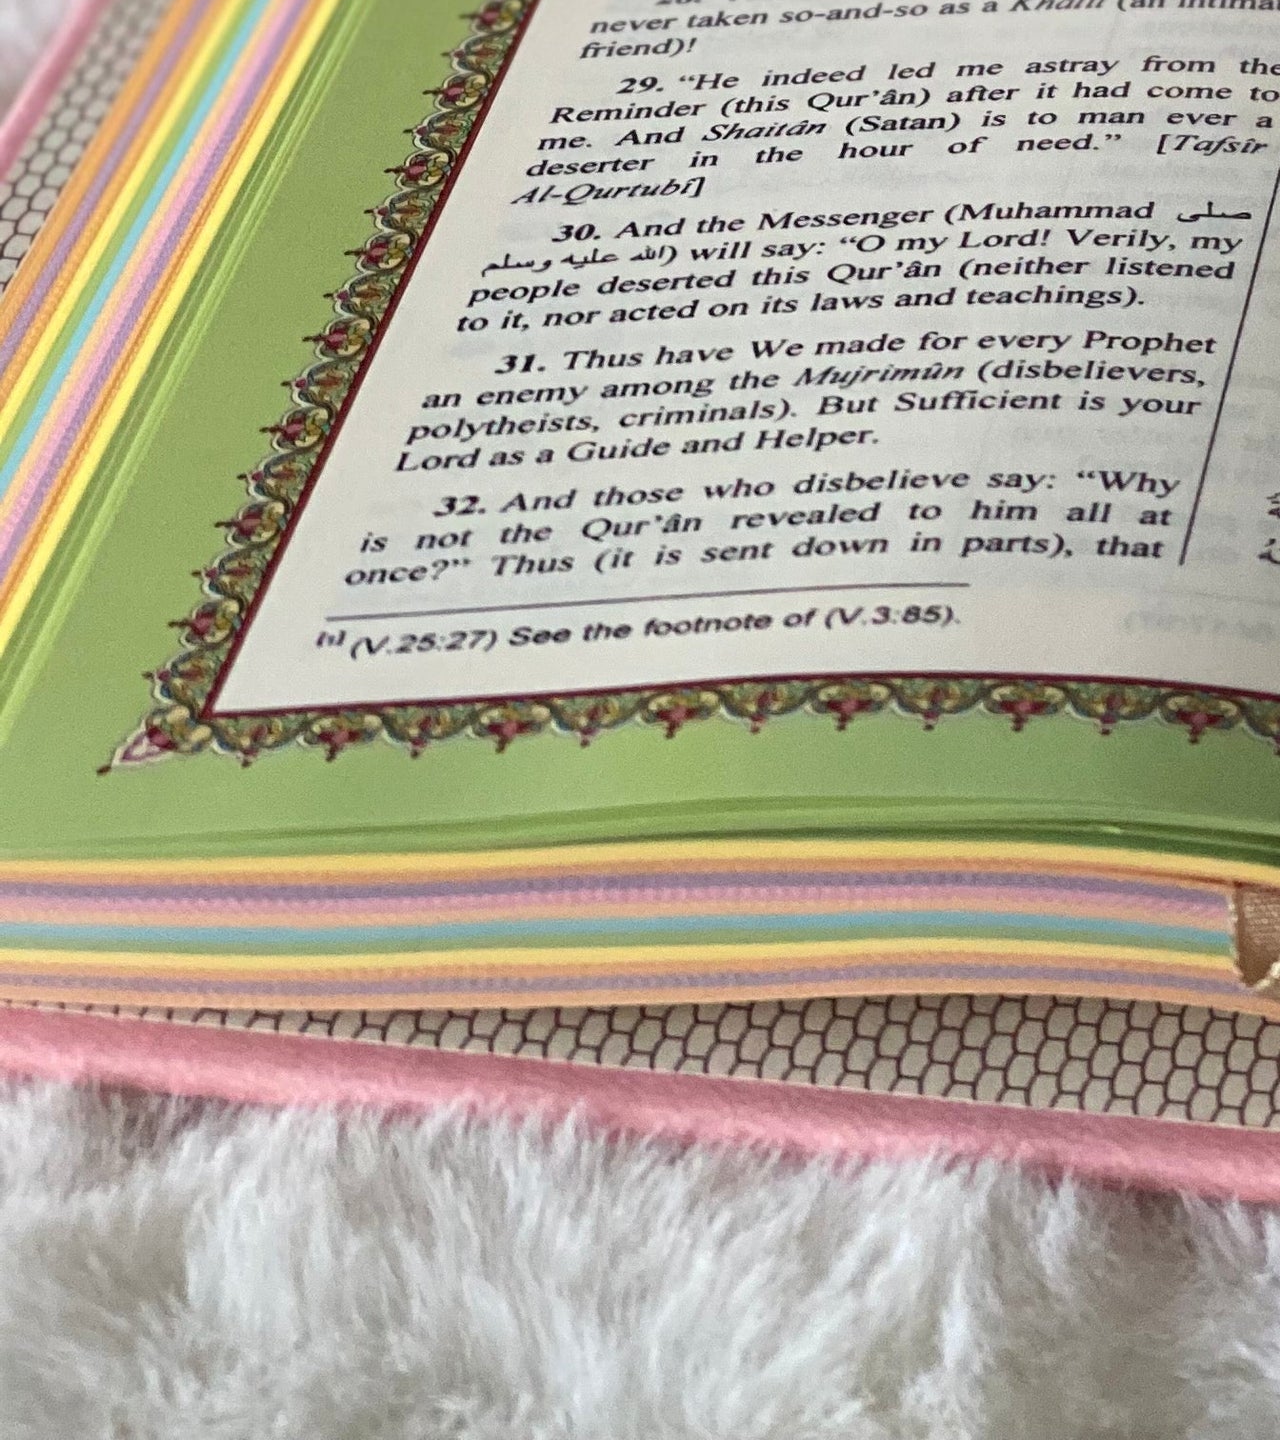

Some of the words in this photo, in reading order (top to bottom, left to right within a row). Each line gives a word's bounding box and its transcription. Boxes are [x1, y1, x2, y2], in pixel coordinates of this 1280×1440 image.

[589, 17, 679, 35] never
[686, 10, 769, 30] taken
[778, 1, 929, 24] so-and-so
[937, 1, 971, 16] as
[981, 0, 999, 14] a
[578, 36, 698, 60] friend)!
[550, 222, 602, 244] 30.
[613, 216, 687, 240] And
[695, 214, 747, 235] the
[756, 209, 936, 231] Messenger
[943, 200, 1156, 226] (Muhammad
[689, 240, 753, 262] will
[760, 241, 827, 262] say:
[894, 236, 950, 256] my
[957, 227, 1052, 250] Lord!
[1065, 228, 1177, 253] Verily,
[1189, 235, 1244, 256] my
[465, 278, 582, 309] people
[595, 268, 738, 296] deserted
[750, 265, 811, 287] this
[958, 255, 1092, 281] (neither
[1103, 256, 1236, 281] listened
[456, 315, 490, 333] to
[499, 309, 531, 333] it,
[541, 309, 602, 328] nor
[607, 298, 701, 324] acted
[707, 301, 750, 319] on
[760, 294, 799, 315] its
[809, 291, 885, 313] laws
[893, 286, 958, 308] and
[965, 284, 1146, 310] teachings).
[493, 352, 547, 376] 31.
[562, 348, 645, 371] Thus
[654, 344, 735, 366] have
[750, 338, 805, 360] We
[813, 332, 907, 357] made
[917, 330, 969, 352] for
[976, 334, 1073, 354] every
[1081, 329, 1218, 357] Prophet
[420, 392, 463, 410] an
[475, 385, 590, 407] enemy
[599, 377, 716, 400] among
[728, 369, 781, 392] the
[976, 358, 1206, 389] (disbelievers,
[404, 411, 601, 447] polytheists,
[617, 397, 797, 429] criminals).
[815, 394, 880, 417] But
[893, 388, 1063, 413] Sufficient
[1077, 389, 1107, 412] is
[1117, 396, 1203, 418] your
[394, 446, 483, 473] Lord
[487, 449, 526, 468] as
[534, 448, 556, 465] a
[566, 436, 672, 463] Guide
[680, 430, 746, 455] and
[753, 426, 879, 453] Helper.
[507, 625, 573, 648] See
[581, 621, 634, 643] the
[643, 613, 774, 637] footnote
[782, 607, 818, 629] of
